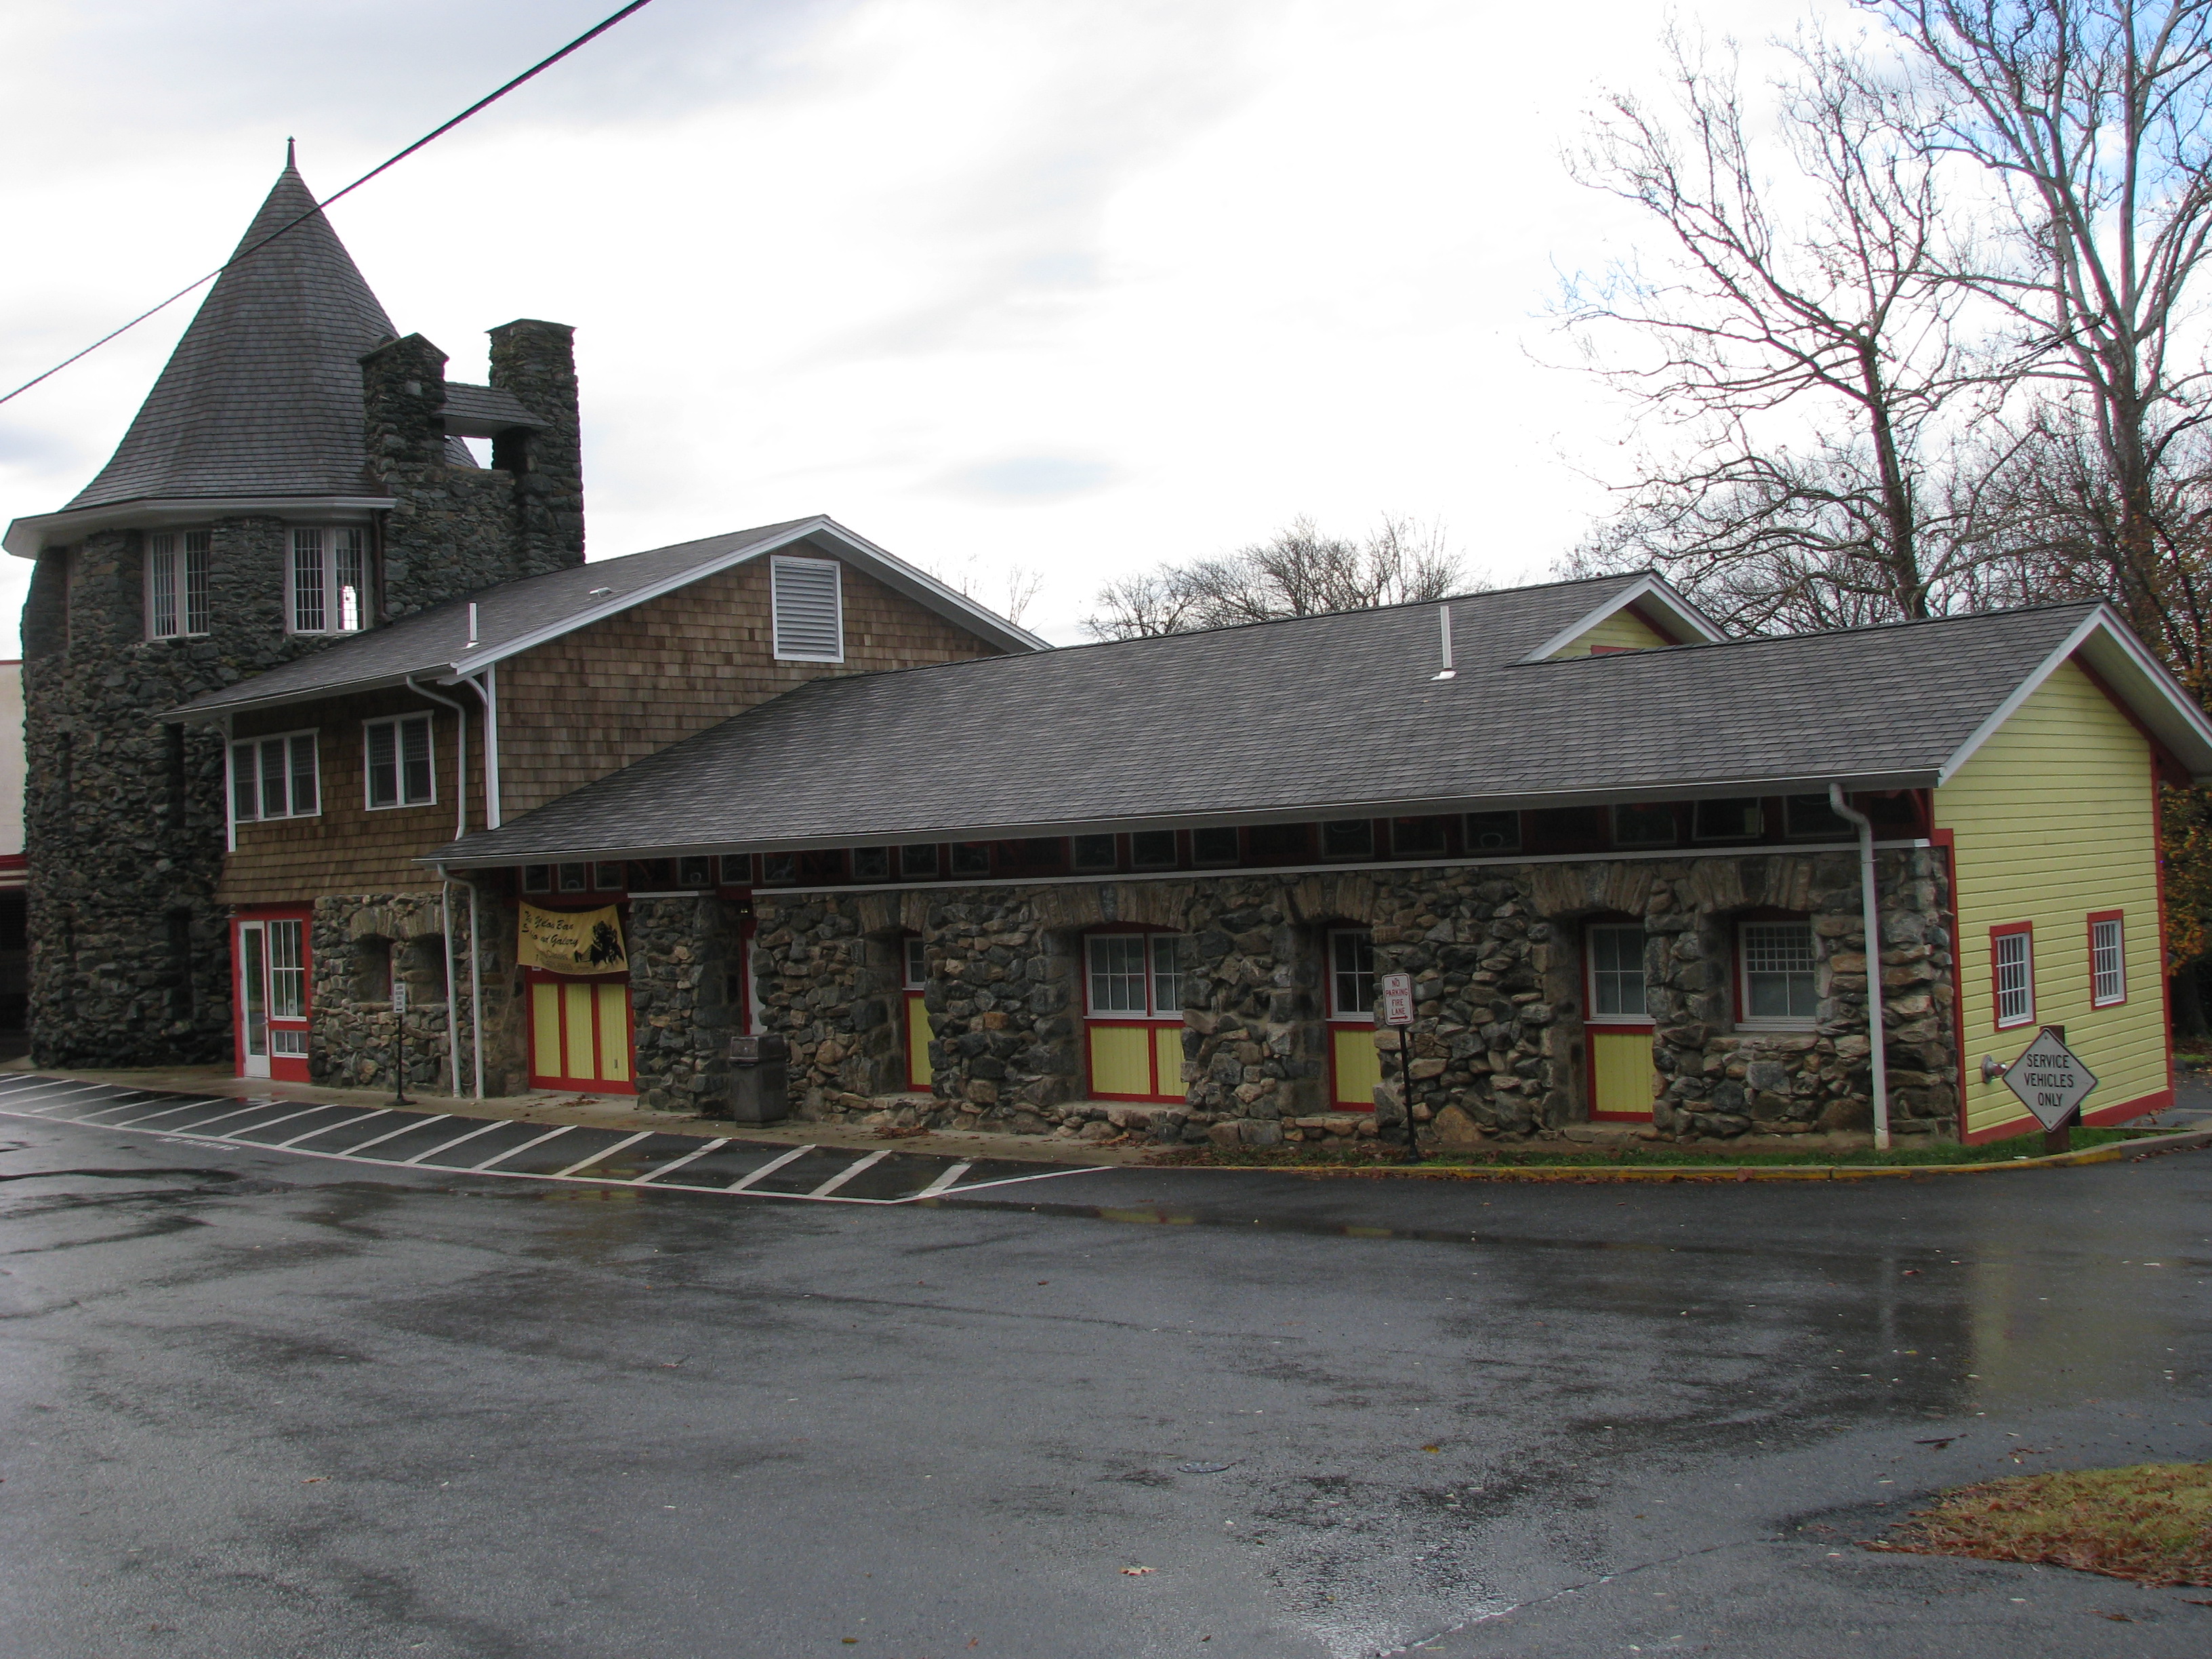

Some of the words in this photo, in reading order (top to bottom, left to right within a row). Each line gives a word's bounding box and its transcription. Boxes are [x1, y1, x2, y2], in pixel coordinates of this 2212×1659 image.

[1391, 979, 1400, 987] NO
[1385, 988, 1408, 997] PARKING
[1392, 999, 1404, 1007] FIRE
[1392, 1007, 1405, 1016] LANE
[2026, 1053, 2070, 1069] SERVICE
[2024, 1073, 2074, 1088] VEHICLES
[2037, 1092, 2063, 1107] ONLY
